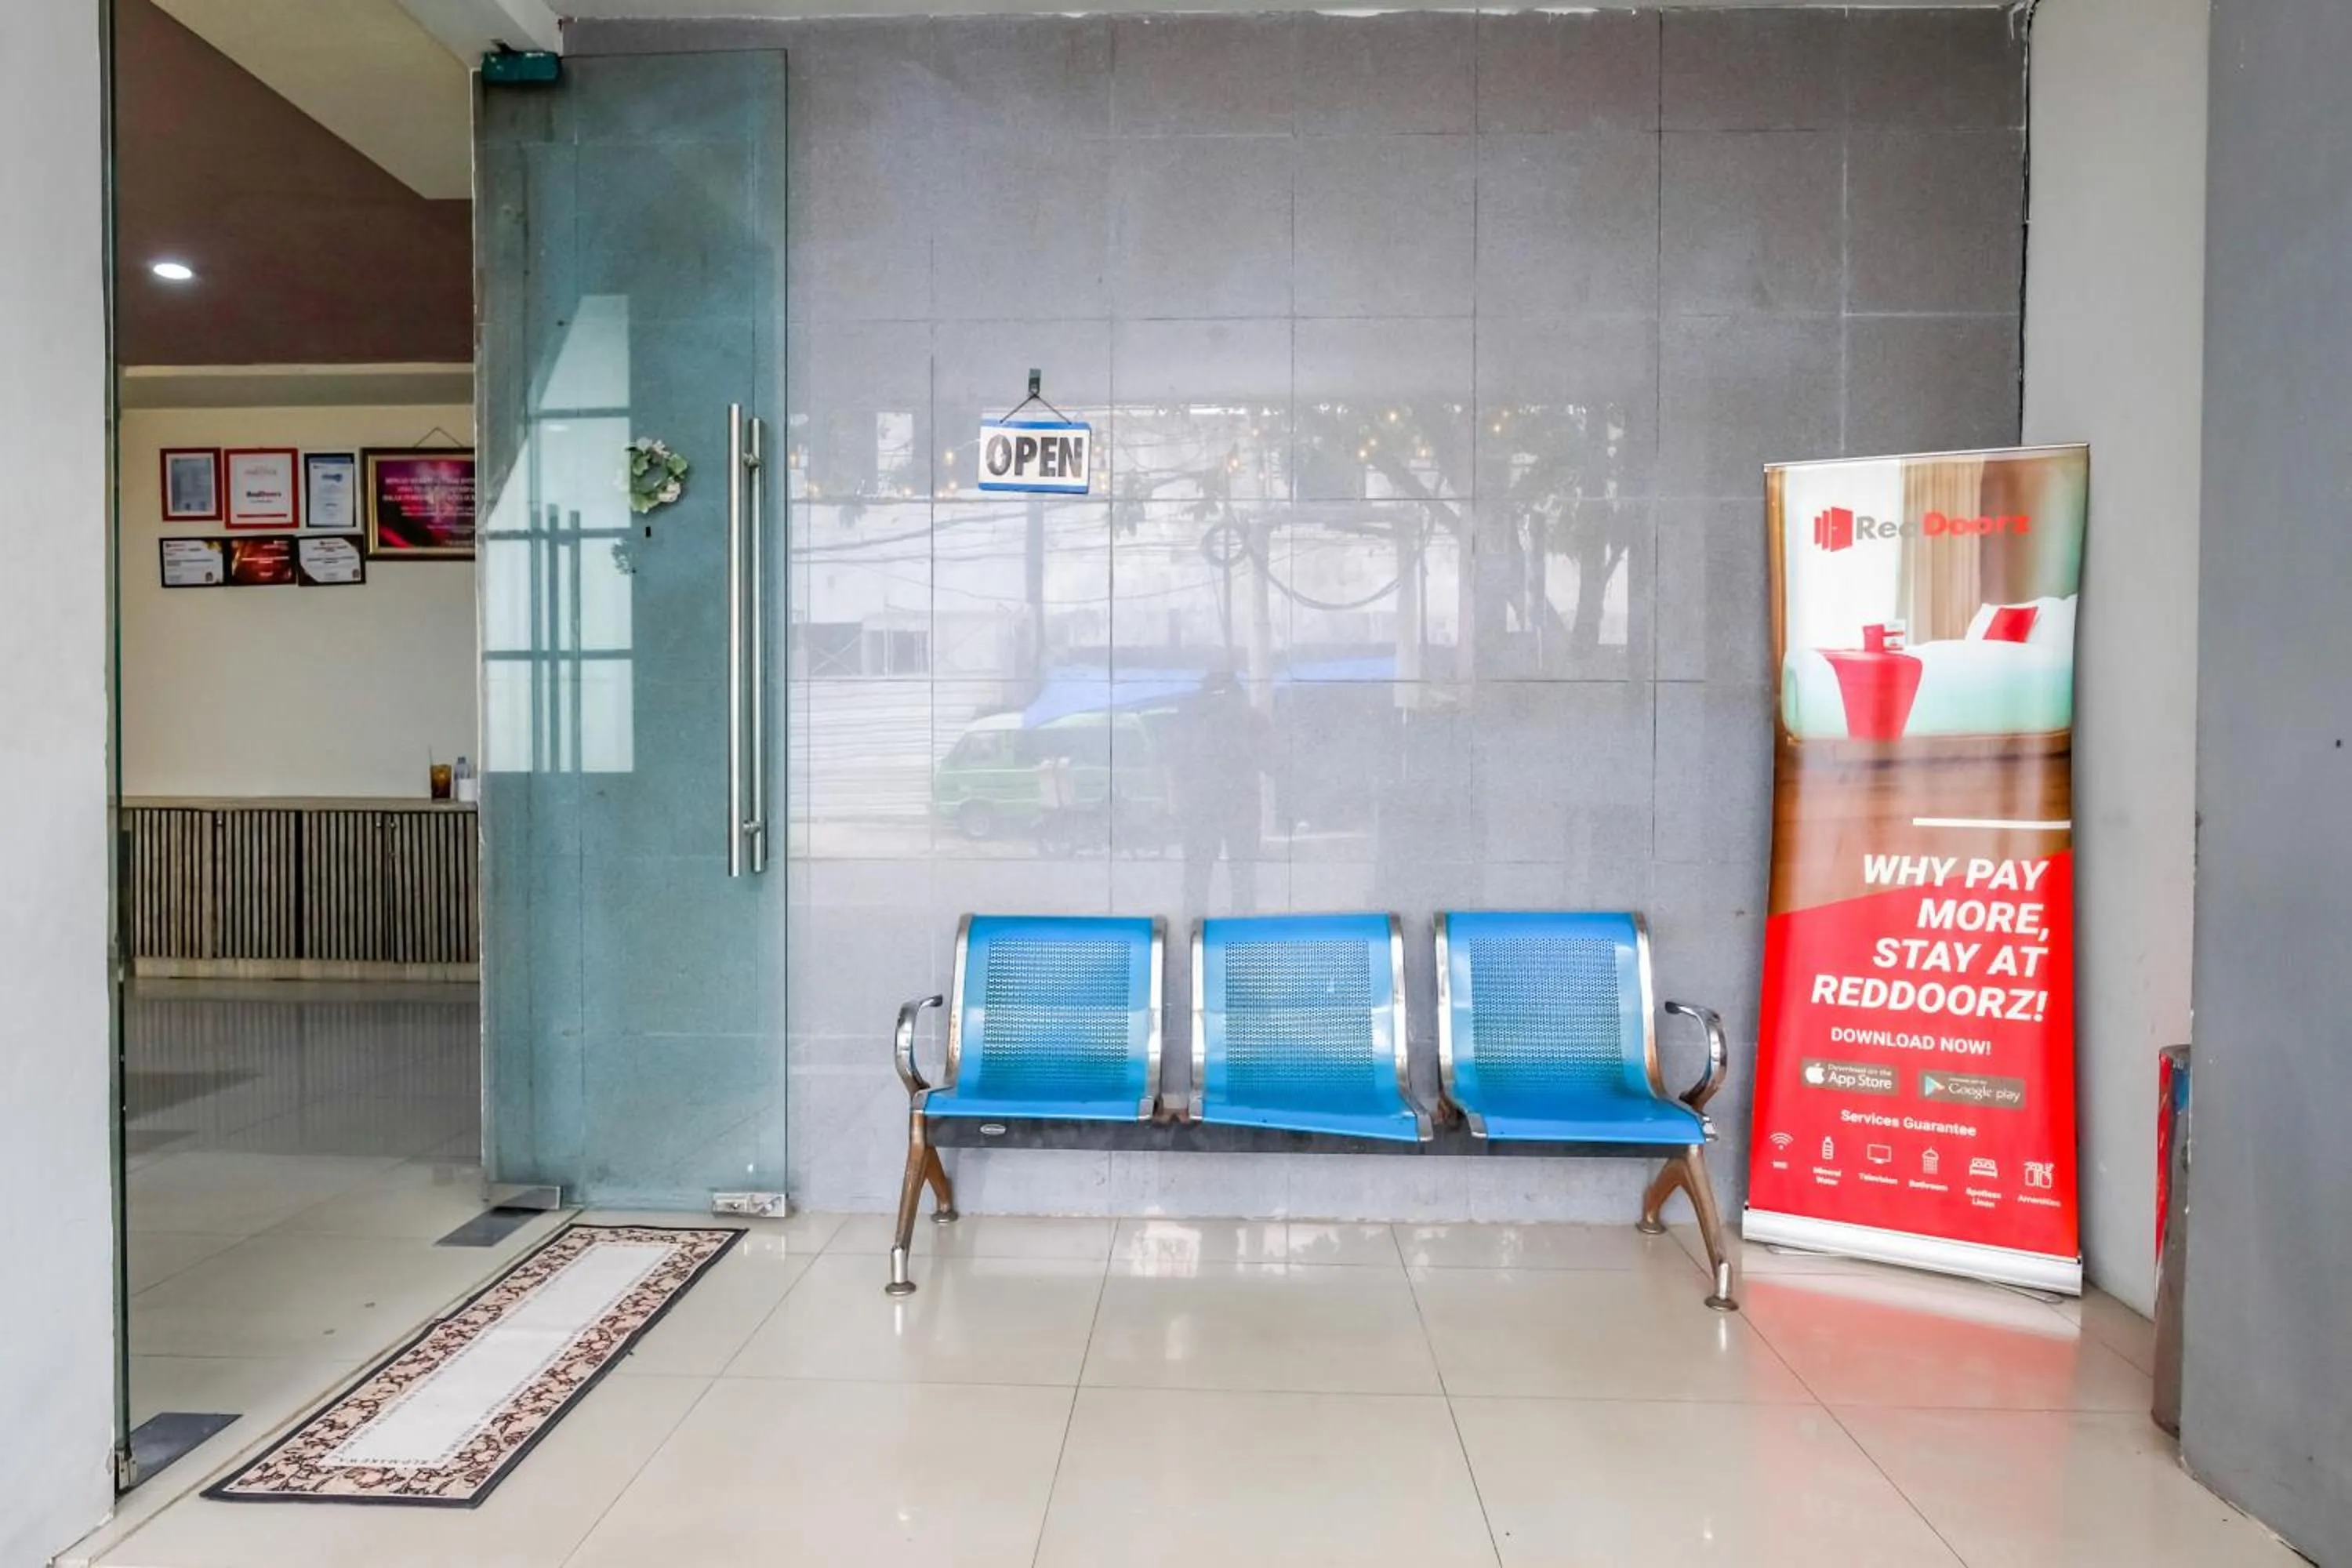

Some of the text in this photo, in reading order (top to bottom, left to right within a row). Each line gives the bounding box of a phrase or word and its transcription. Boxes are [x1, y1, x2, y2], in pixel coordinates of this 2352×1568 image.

[985, 434, 1083, 477] OPEN
[1864, 855, 2049, 891] WHY PAY
[1917, 898, 2050, 942] MORE,
[1872, 938, 2049, 978] STAY AT
[1811, 975, 2049, 1022] REDDOORZ!
[1831, 1027, 1991, 1055] DOWNLOAD NOW!
[1828, 1072, 1893, 1090] App Store
[1947, 1084, 2021, 1103] Google play
[1841, 1109, 1976, 1137] Services Guarantee
